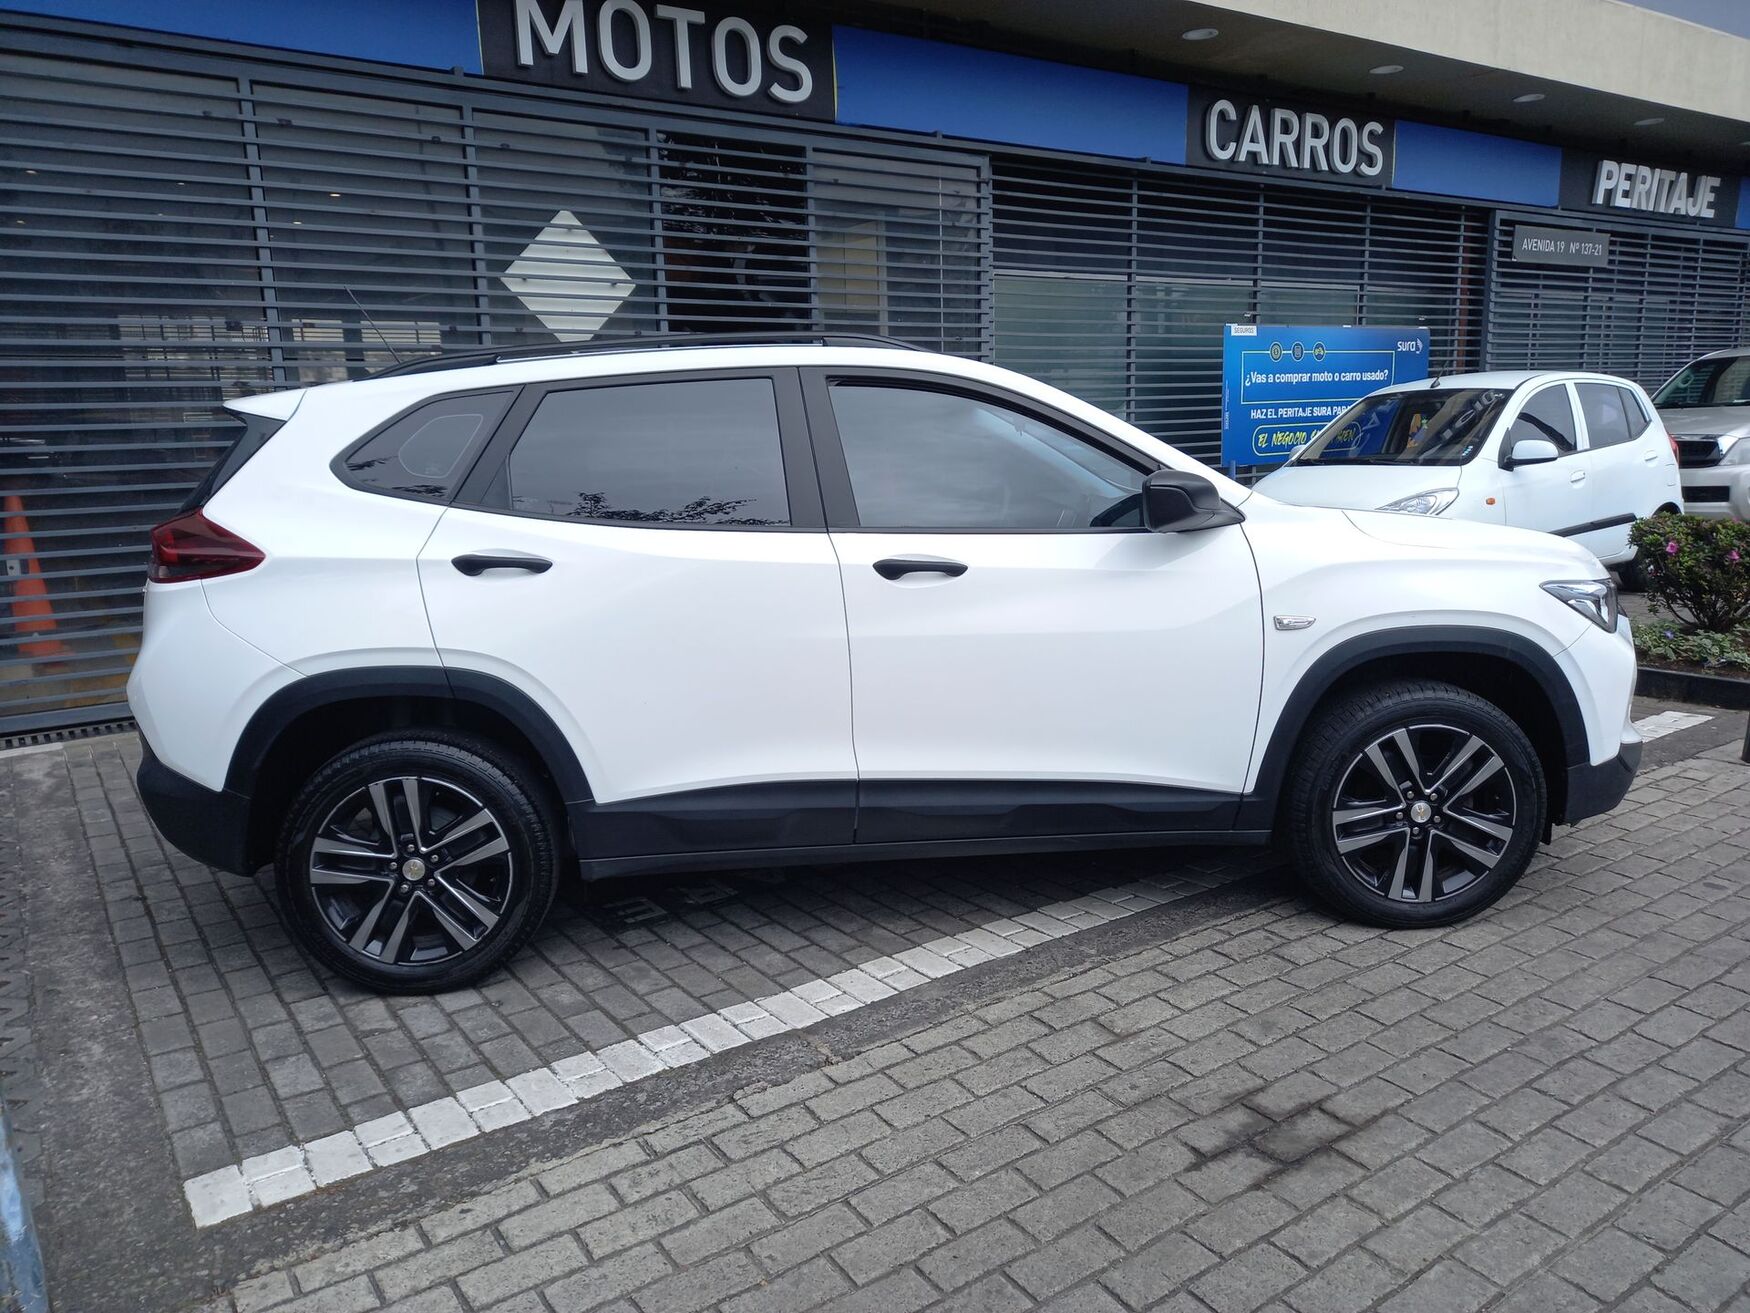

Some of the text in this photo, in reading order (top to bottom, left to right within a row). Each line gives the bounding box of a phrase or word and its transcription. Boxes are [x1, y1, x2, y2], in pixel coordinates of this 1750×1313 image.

[515, 0, 813, 103] MOTOS
[1206, 100, 1384, 177] CARROS
[1592, 160, 1721, 218] PERITAJE
[1522, 239, 1555, 253] AVENIDA
[1557, 240, 1565, 253] 19
[1581, 243, 1602, 256] 137-21
[1397, 341, 1416, 351] sura
[1245, 369, 1389, 386] ¿Vas a comprar moto o carro usado?
[1251, 404, 1350, 419] HAZ EL PERITAJE SURA PAR
[1257, 433, 1269, 448] EL
[1271, 431, 1307, 448] NEGOCIO
